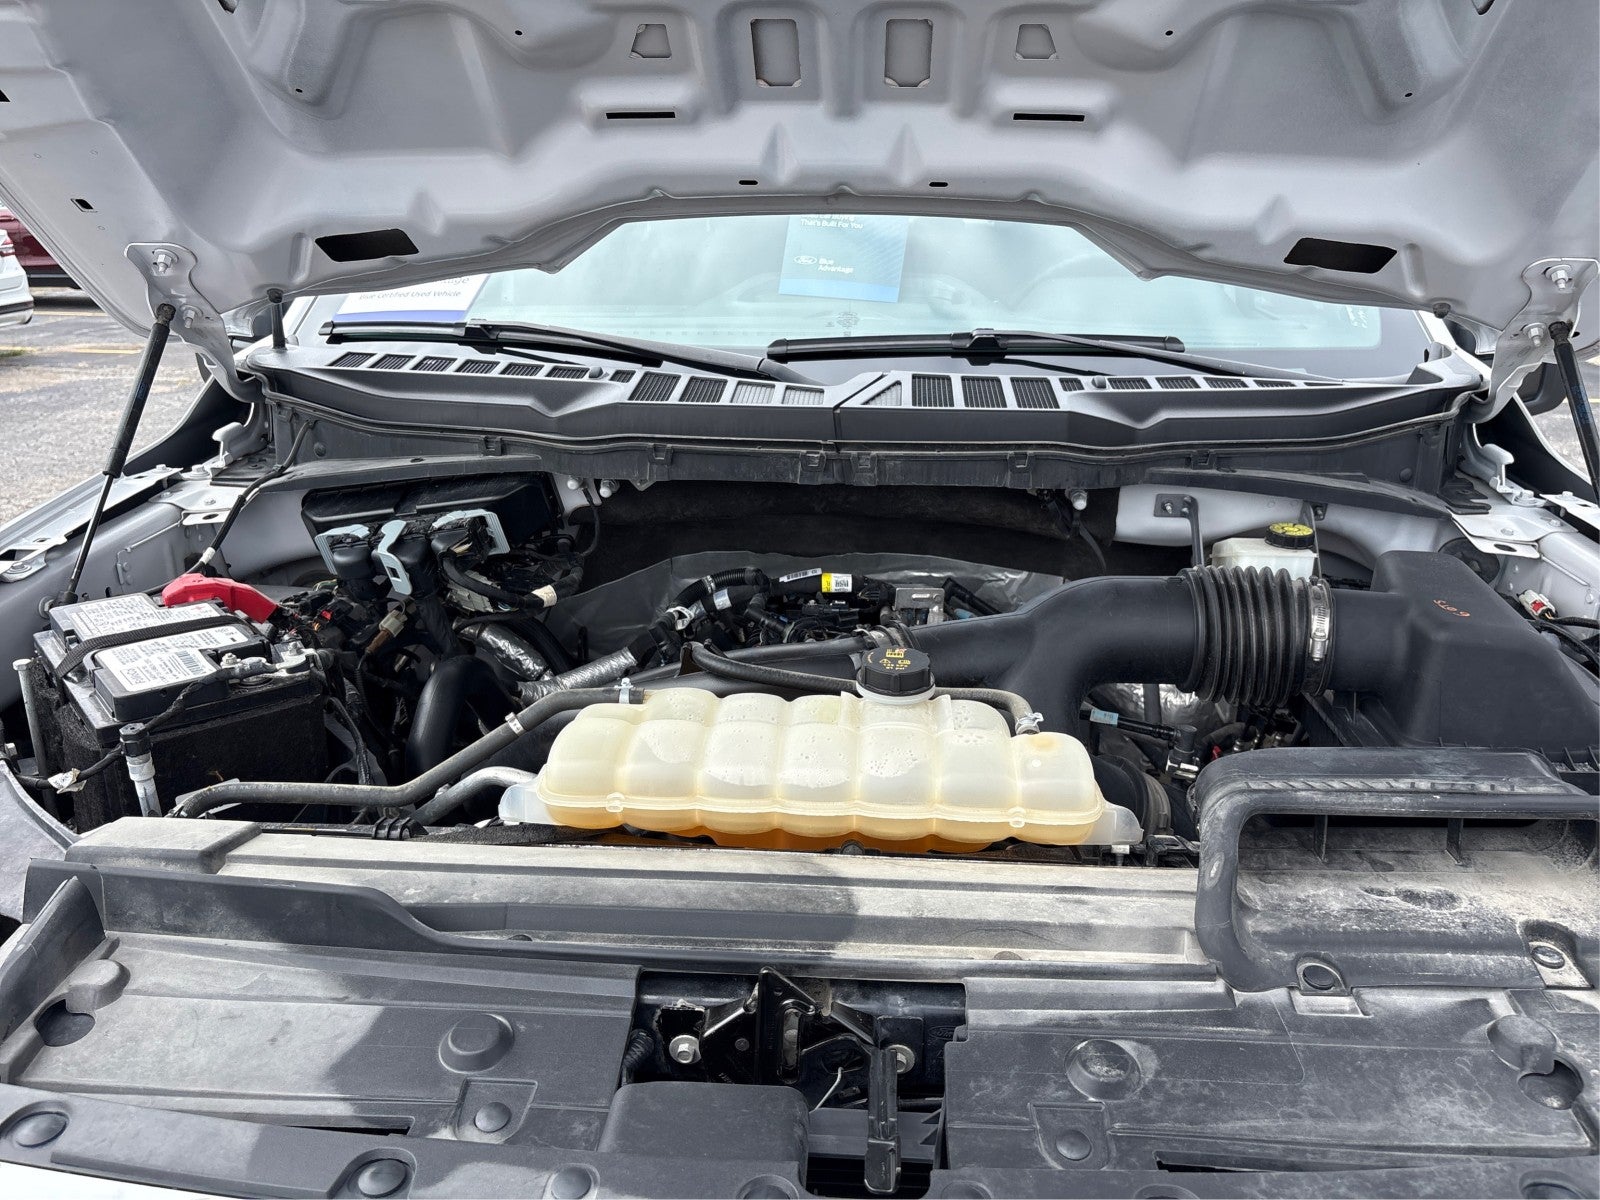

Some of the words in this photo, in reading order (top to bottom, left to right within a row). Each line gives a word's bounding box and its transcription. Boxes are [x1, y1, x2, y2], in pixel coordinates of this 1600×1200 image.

[800, 218, 821, 226] That's
[818, 265, 854, 273] Advantage
[377, 290, 409, 298] Certified
[411, 290, 431, 298] Used
